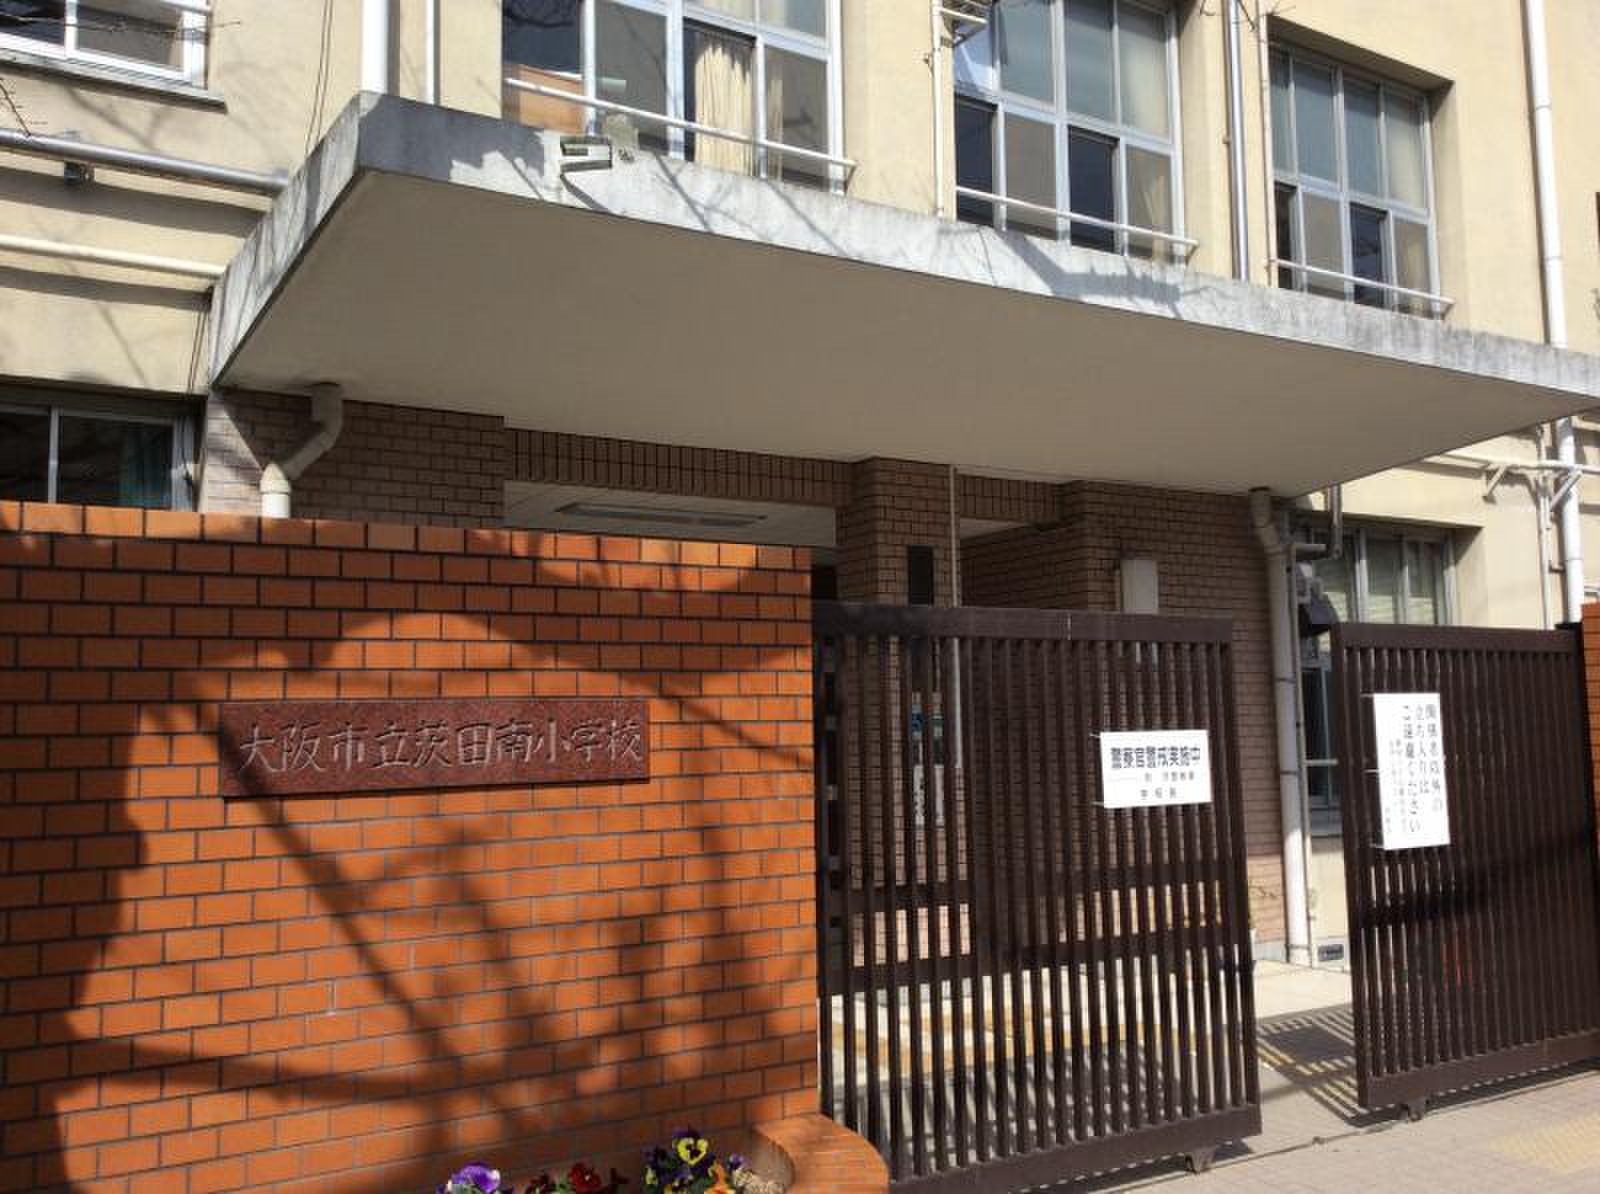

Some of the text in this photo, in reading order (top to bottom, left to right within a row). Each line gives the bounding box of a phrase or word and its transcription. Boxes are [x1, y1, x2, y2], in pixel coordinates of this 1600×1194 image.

[239, 719, 643, 774] 大阪市立茨田南小学校
